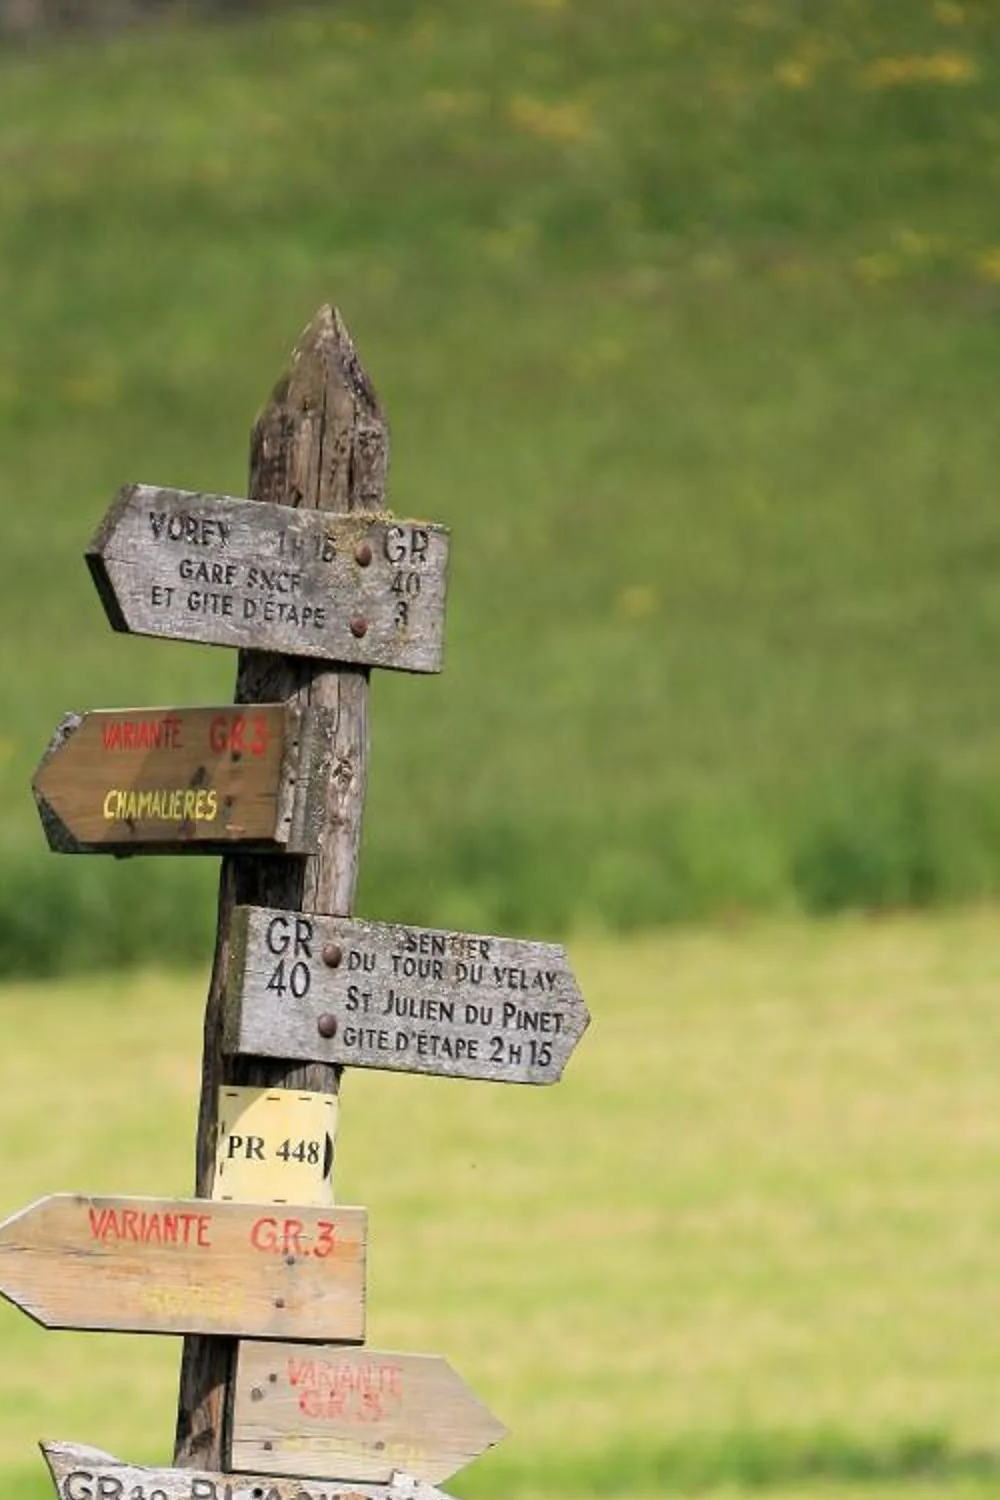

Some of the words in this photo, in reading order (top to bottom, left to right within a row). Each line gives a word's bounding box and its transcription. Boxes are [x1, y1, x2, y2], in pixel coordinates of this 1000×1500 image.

[383, 526, 429, 565] GR
[179, 559, 238, 585] GARE
[247, 566, 302, 593] SNCF
[391, 568, 420, 600] 40
[151, 585, 176, 607] ET
[187, 591, 234, 617] GITE
[393, 601, 409, 629] 3
[102, 716, 183, 751] VARIANTE
[265, 917, 313, 959] GR
[405, 933, 491, 961] SENTIER
[265, 958, 311, 999] 40
[347, 951, 377, 973] DU
[391, 954, 445, 982] TOUR
[455, 962, 484, 985] DU
[493, 966, 558, 992] VELAY
[382, 989, 456, 1024] JULIEN
[464, 1004, 493, 1026] DU
[502, 1001, 566, 1034] PINET
[342, 1026, 392, 1051] GITE
[227, 1134, 266, 1161] PR
[275, 1137, 320, 1165] 448
[88, 1207, 212, 1248] VARIANTE
[285, 1356, 403, 1397] VARIANTE
